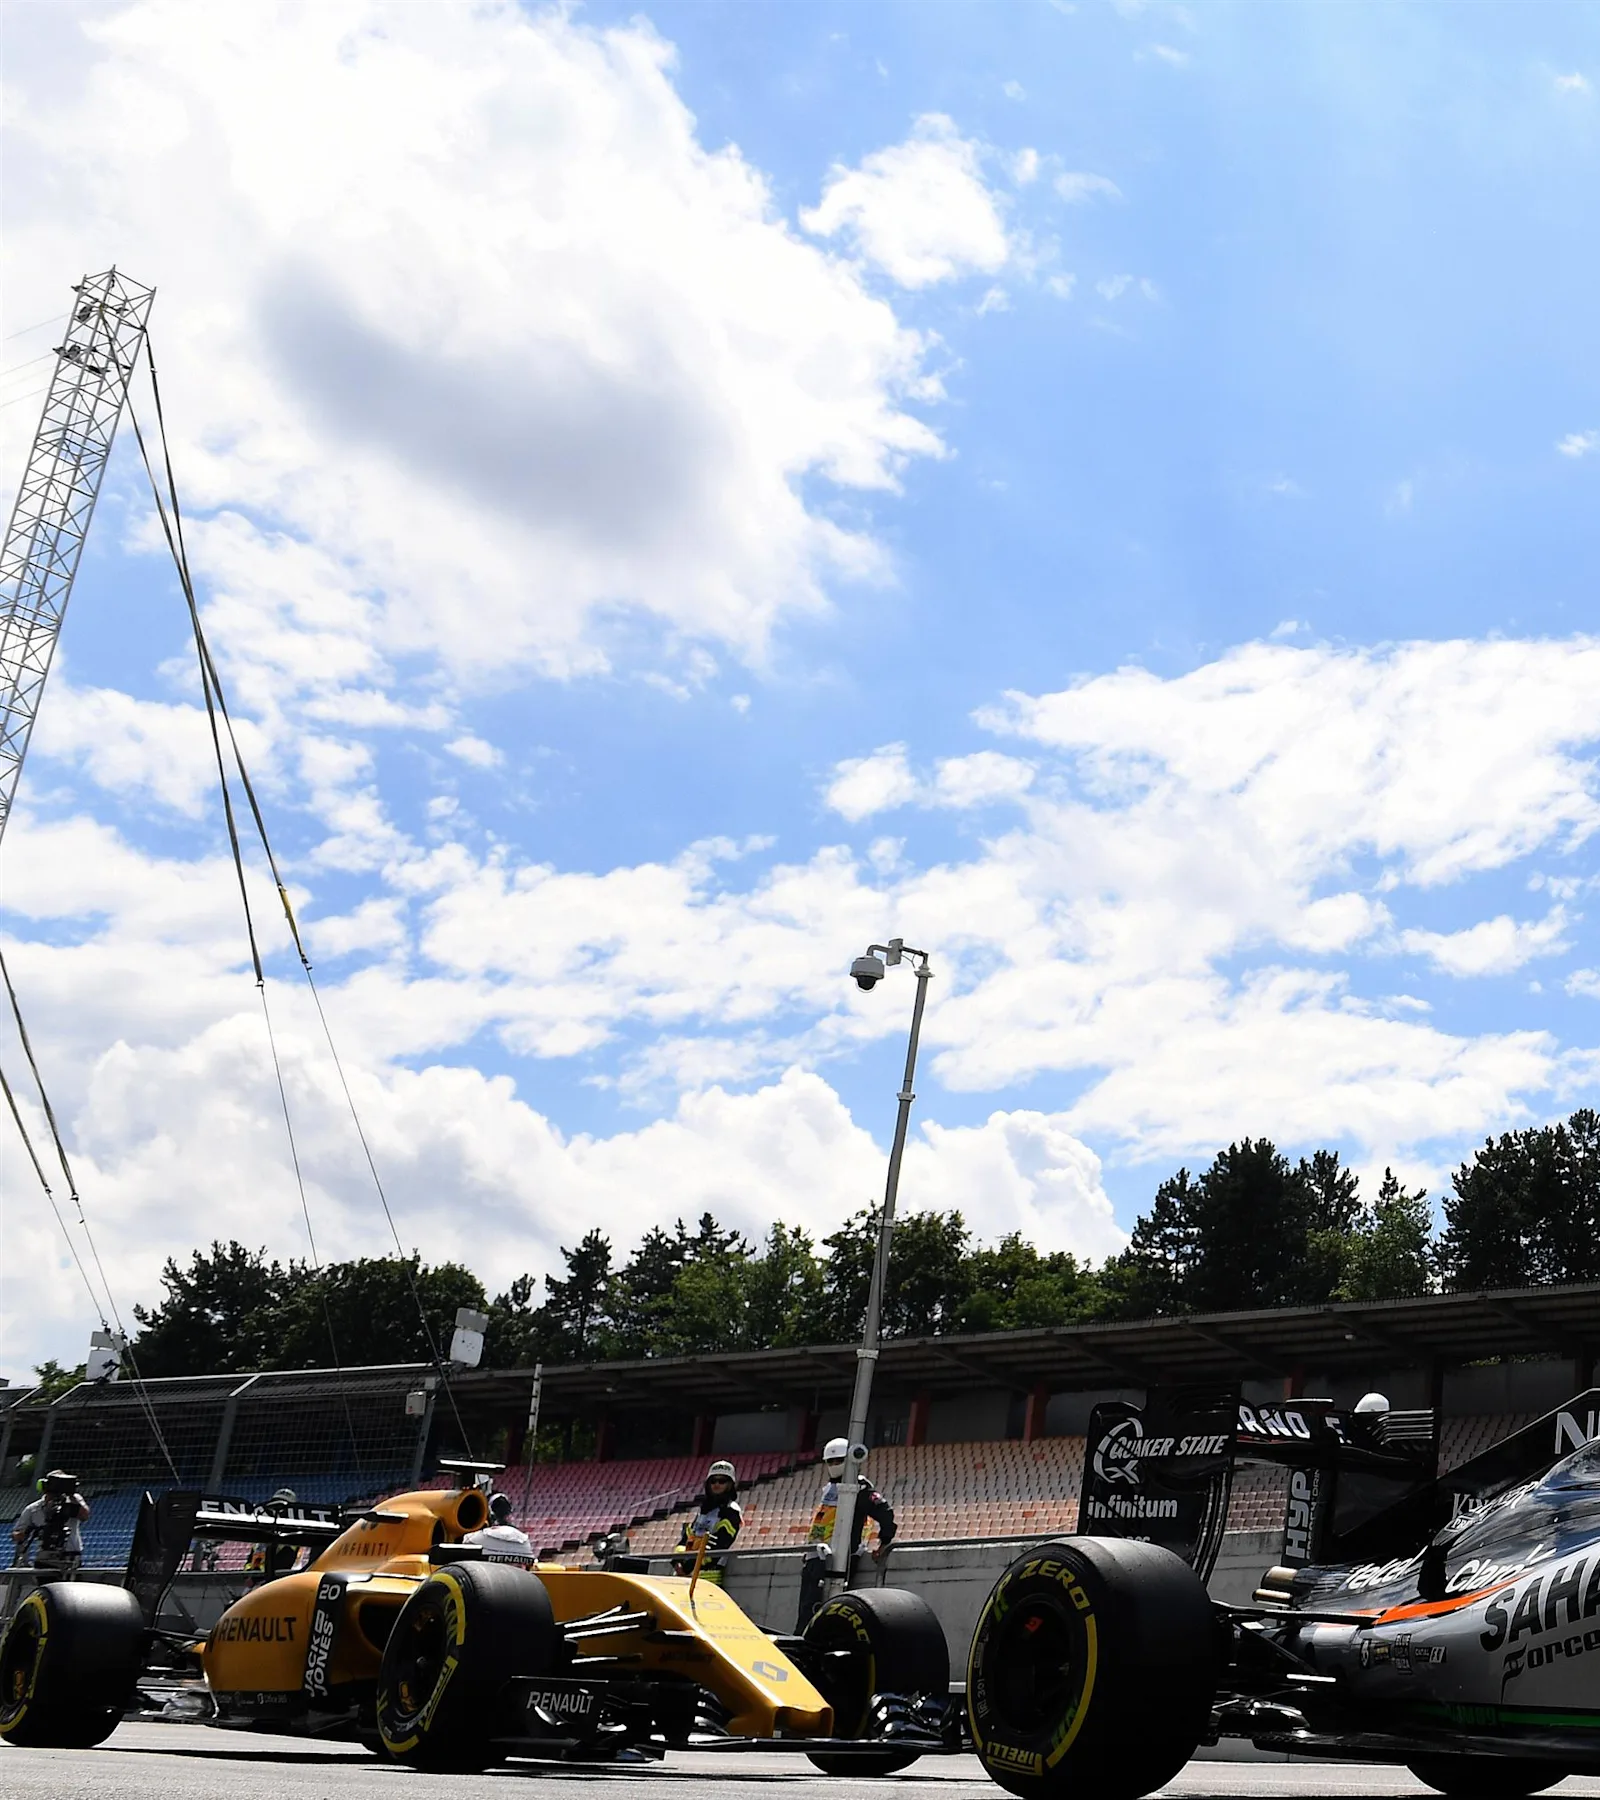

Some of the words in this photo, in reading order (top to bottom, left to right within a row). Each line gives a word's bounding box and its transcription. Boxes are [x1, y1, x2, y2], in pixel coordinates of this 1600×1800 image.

[1109, 1436, 1175, 1459] QUAKER
[1175, 1434, 1230, 1456] STATE
[1087, 1494, 1178, 1519] infinitum
[1285, 1468, 1311, 1560] HYP
[336, 1542, 390, 1557] INFINITI
[488, 1555, 534, 1566] RENAULT
[1019, 1559, 1091, 1610] ZERO
[1444, 1558, 1527, 1594] Claro
[318, 1584, 341, 1601] 20
[218, 1617, 297, 1642] RENAULT
[305, 1634, 321, 1698] JACK
[313, 1621, 334, 1697] JONES
[526, 1691, 595, 1715] RENAULT
[987, 1740, 1044, 1777] PIRELLI
